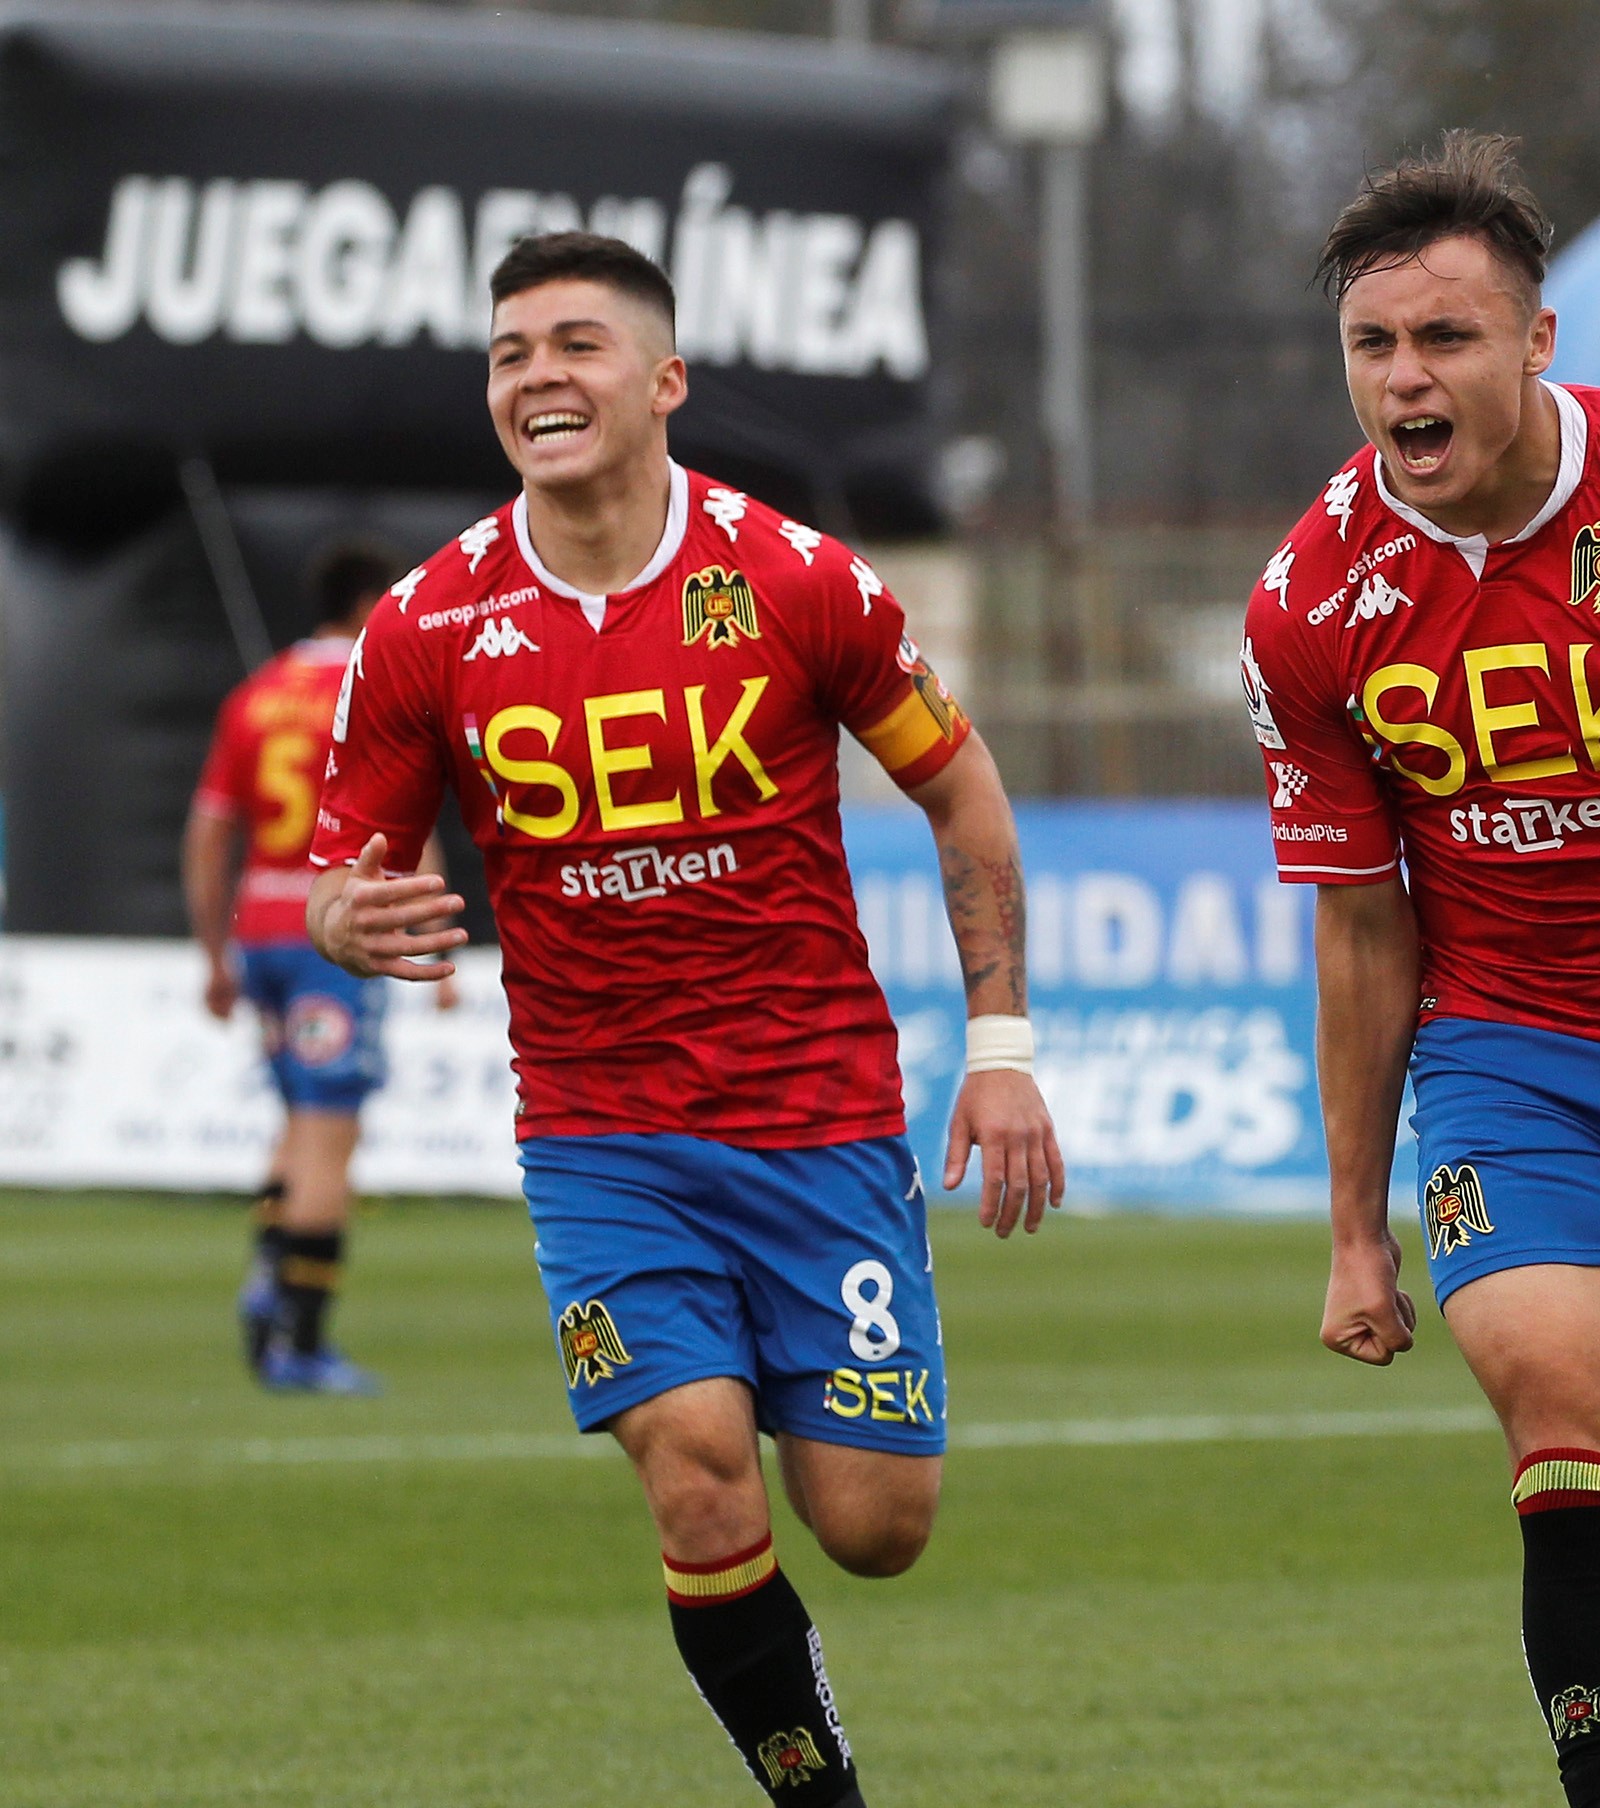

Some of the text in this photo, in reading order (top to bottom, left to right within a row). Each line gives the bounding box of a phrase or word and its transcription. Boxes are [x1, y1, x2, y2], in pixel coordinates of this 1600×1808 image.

[58, 162, 932, 382] JUEGAEÍNEA
[418, 585, 541, 631] aeropst.com
[1306, 533, 1418, 626] aeroost.com
[483, 675, 779, 839] SEK
[560, 842, 738, 903] starken
[1438, 1197, 1460, 1218] UE
[840, 1258, 901, 1363] 8
[830, 1367, 935, 1423] SEK
